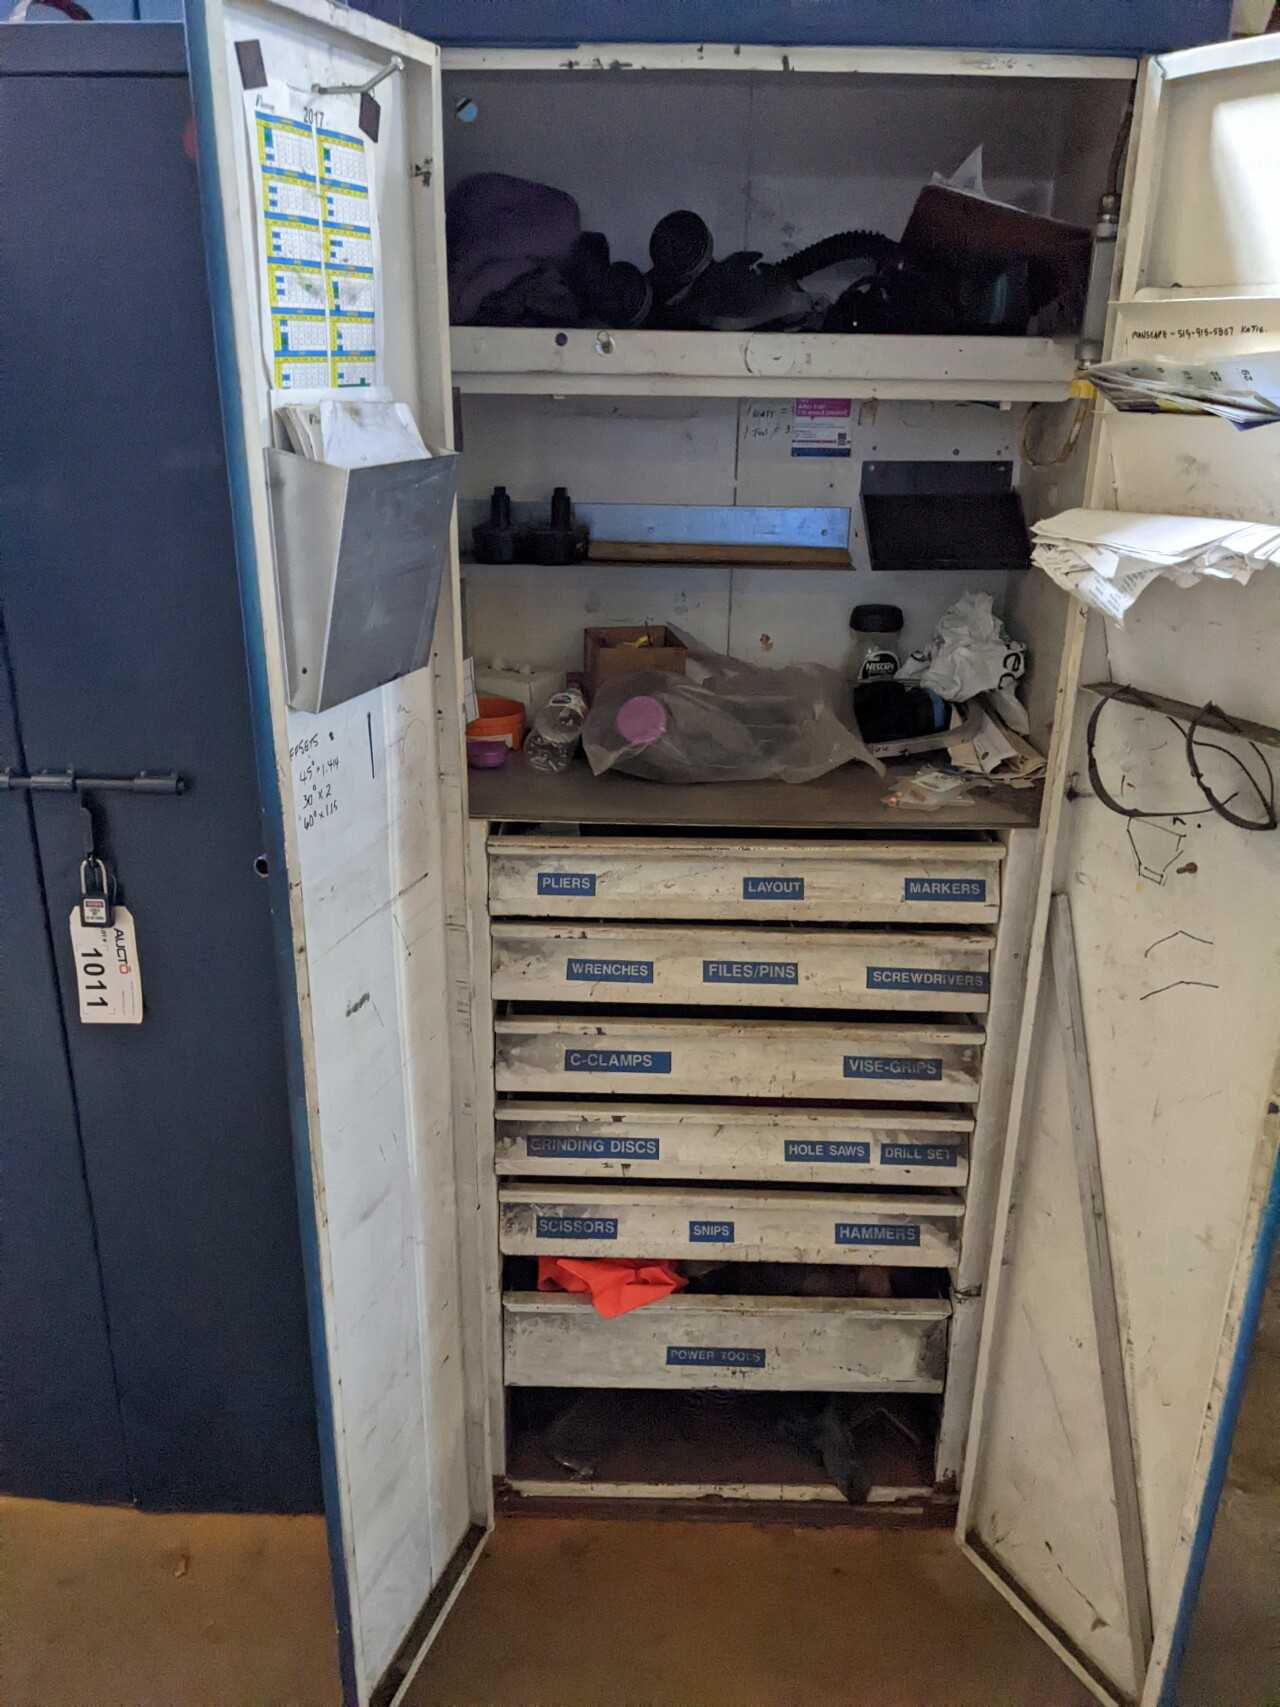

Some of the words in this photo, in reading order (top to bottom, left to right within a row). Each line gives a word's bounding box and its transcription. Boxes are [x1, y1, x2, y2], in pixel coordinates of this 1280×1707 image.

[303, 106, 324, 128] 2017
[541, 876, 591, 891] PLIERS
[747, 879, 801, 894] LAYOUT
[909, 880, 981, 896] MARKERS
[81, 948, 109, 1008] 1011
[571, 962, 649, 978] WRENCHES
[707, 963, 796, 980] FILES/PINS
[872, 970, 984, 987] SCREWDRIVERS
[570, 1052, 653, 1068] C-CLAMPS
[848, 1058, 937, 1075] VISE-GRIPS
[529, 1138, 604, 1153] GRINDING
[609, 1140, 657, 1154] DISCS
[788, 1143, 823, 1157] HOLE
[828, 1144, 866, 1158] SAWS
[884, 1147, 922, 1160] DRILL
[538, 1218, 616, 1235] SCISSORS
[693, 1224, 730, 1238] SNIPS
[838, 1225, 917, 1242] HAMMERS
[670, 1350, 715, 1361] POWER
